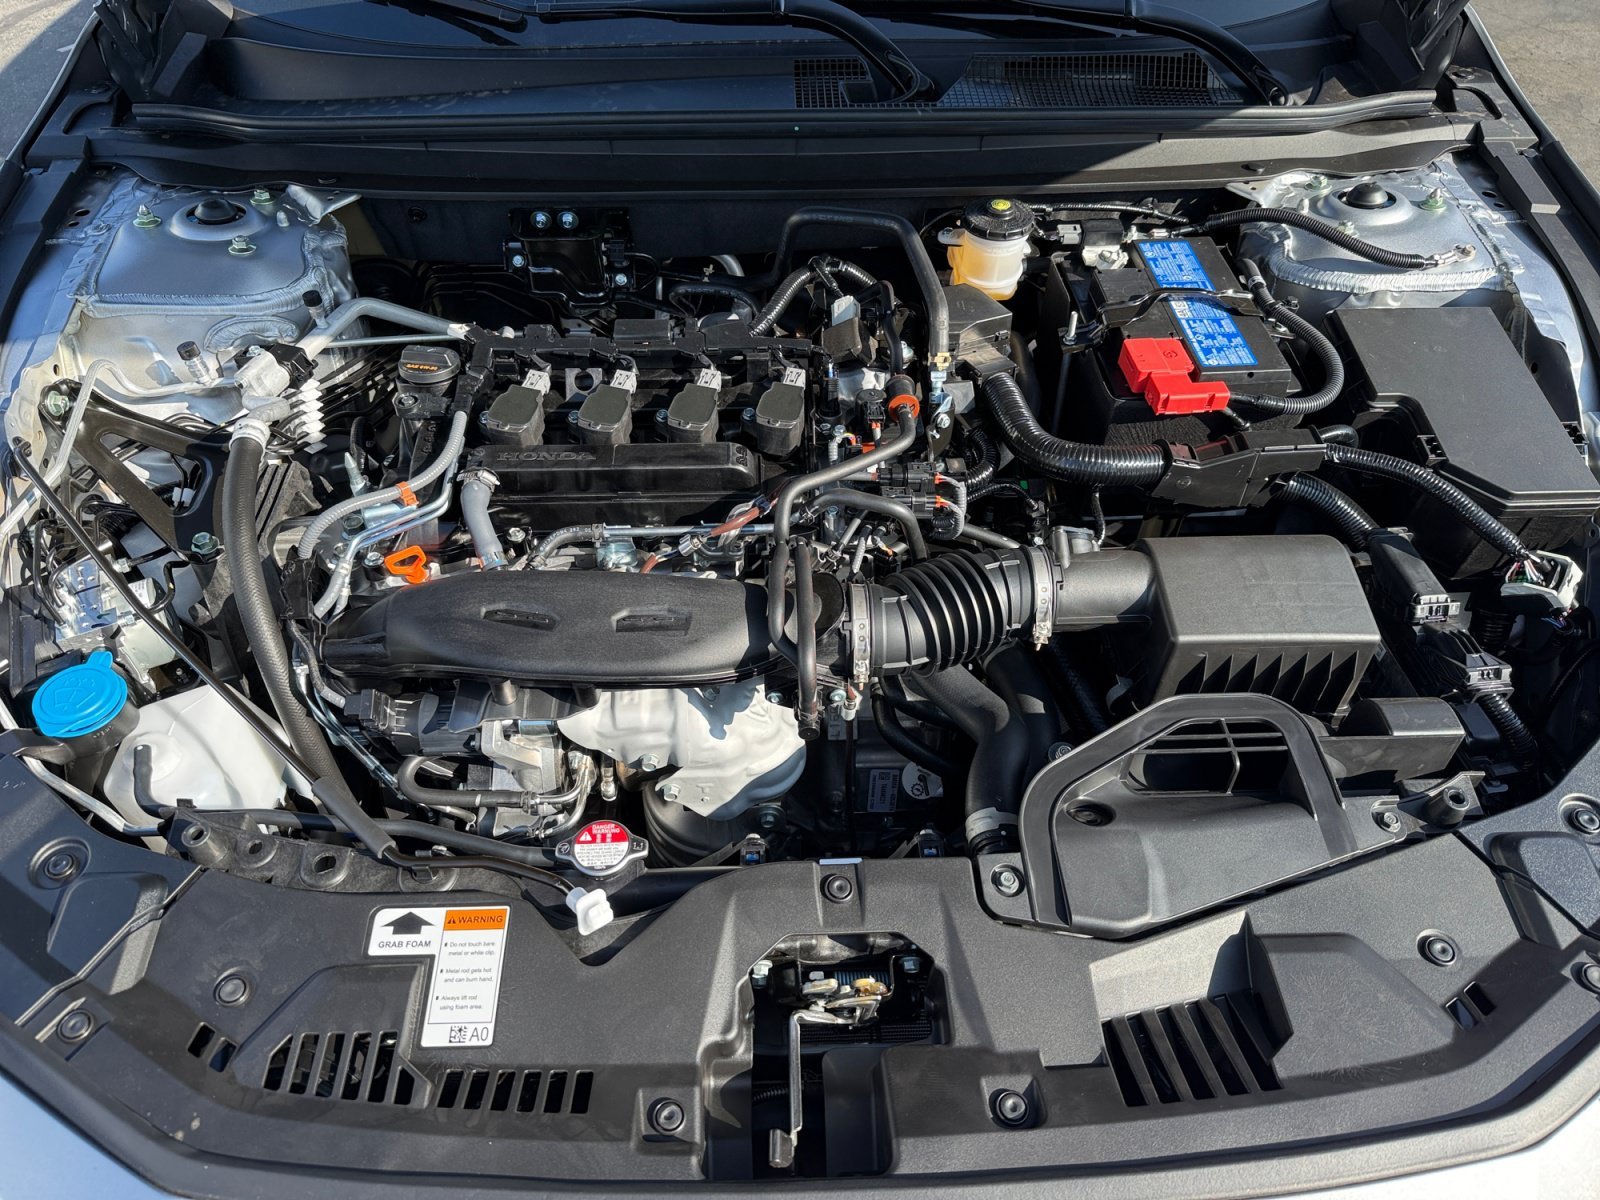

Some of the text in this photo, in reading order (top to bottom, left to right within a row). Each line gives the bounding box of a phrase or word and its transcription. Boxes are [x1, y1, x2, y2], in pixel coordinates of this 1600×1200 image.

[497, 451, 596, 461] HONDA
[458, 915, 503, 923] WARNING
[378, 940, 432, 948] GRAB FOAM
[469, 1026, 489, 1042] A0
